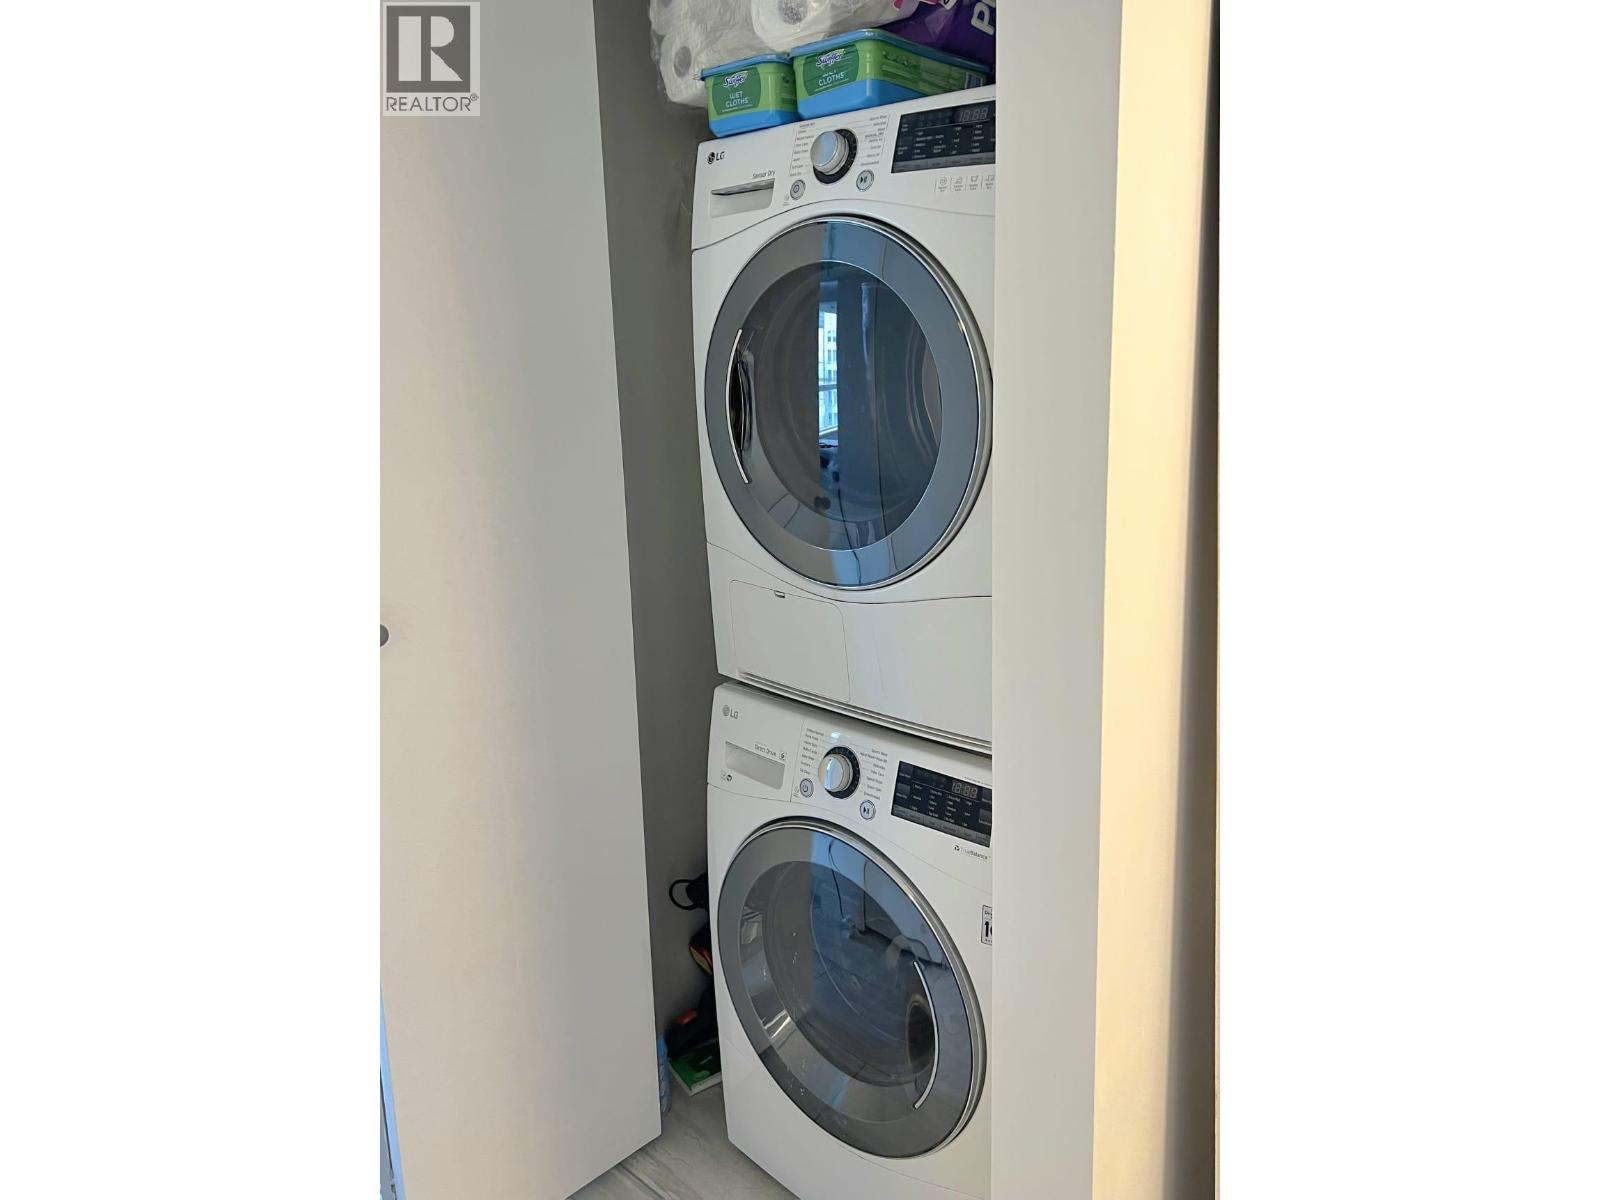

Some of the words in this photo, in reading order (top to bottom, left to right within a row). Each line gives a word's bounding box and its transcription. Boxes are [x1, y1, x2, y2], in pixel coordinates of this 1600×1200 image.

[818, 72, 845, 86] CLOTHS
[730, 91, 743, 99] WET
[725, 97, 749, 108] CLOTHS
